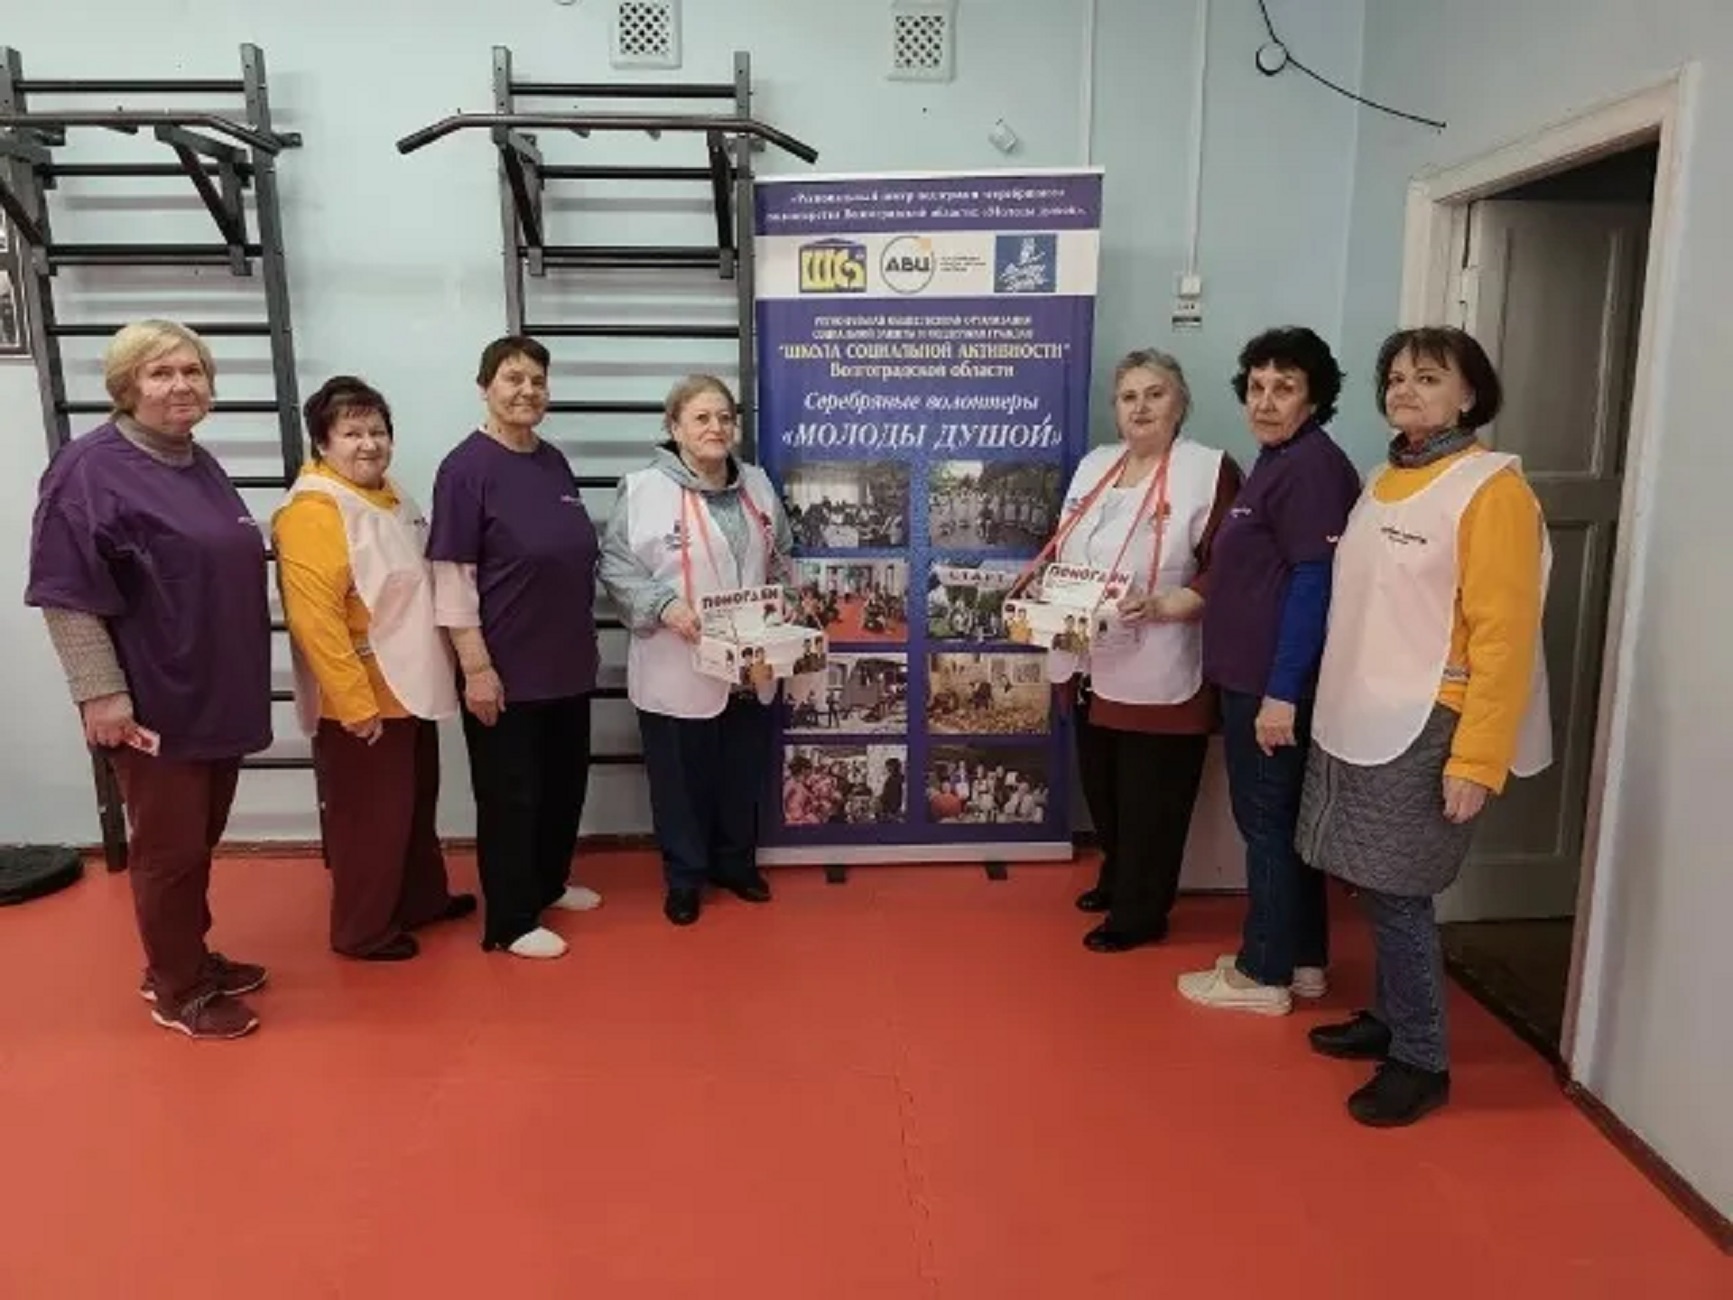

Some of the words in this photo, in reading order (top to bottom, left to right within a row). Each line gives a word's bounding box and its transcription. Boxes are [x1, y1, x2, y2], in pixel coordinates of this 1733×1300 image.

[884, 256, 930, 272] АВЦ
[846, 340, 952, 360] СОЦИАЛЬНОЙ
[829, 361, 947, 382] Волгоградской
[949, 360, 1015, 378] области
[803, 390, 921, 415] Серебряные
[782, 421, 927, 451] «МОЛОДЫ
[932, 412, 1063, 451] ДУШОЙ»
[1050, 564, 1130, 585] ПОМОГАМ
